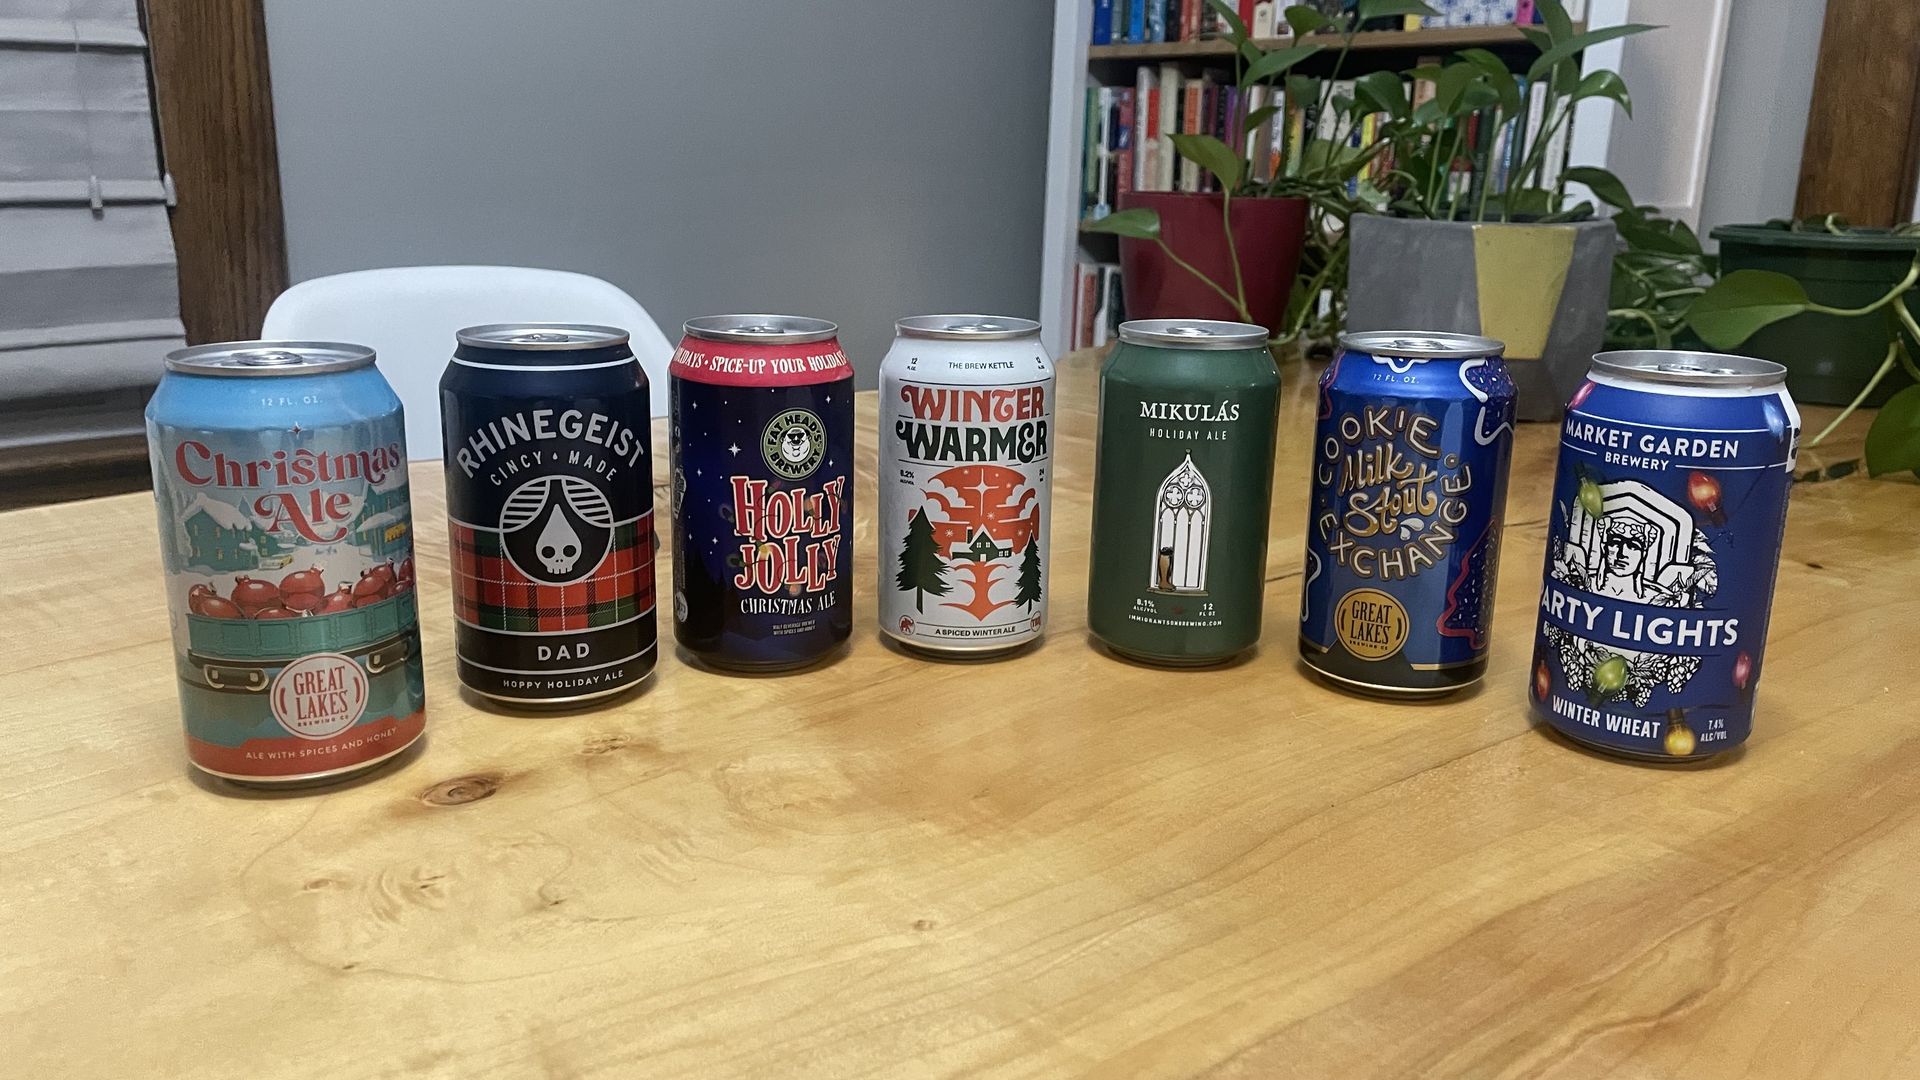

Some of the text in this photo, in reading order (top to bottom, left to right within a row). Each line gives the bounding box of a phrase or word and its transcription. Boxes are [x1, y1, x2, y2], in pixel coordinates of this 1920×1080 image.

[678, 347, 706, 369] IDAYS
[709, 355, 767, 374] SPICE-UP
[771, 357, 807, 375] YOUR
[948, 361, 1015, 370] THE BREW KETTLE
[1372, 373, 1383, 382] 12
[261, 398, 273, 407] 12
[901, 384, 1045, 423] WINTER
[1140, 400, 1241, 422] MIKULÁS
[456, 408, 645, 479] RHINEGEIST
[767, 414, 822, 446] FAT HEAD'S
[895, 419, 1048, 464] WARMER
[1150, 427, 1228, 441] HOLIDAY ALE
[1318, 405, 1440, 486] COOKIE
[1565, 418, 1739, 458] MARKET GARDEN
[175, 440, 400, 487] Christmas
[490, 449, 618, 486] CINCY MADE
[769, 448, 822, 475] BREWERY
[1338, 442, 1414, 497] Milk
[1605, 451, 1670, 471] BREWERY
[730, 475, 846, 543] HOLLY
[1343, 462, 1438, 537] Stout
[253, 488, 352, 544] Ale
[1320, 464, 1472, 580] EXCHANGE
[734, 535, 842, 595] JOLLY
[740, 591, 837, 616] CHRISTMAS ALE
[1203, 603, 1214, 611] 12
[1352, 600, 1393, 624] GREAT
[1540, 585, 1739, 647] ARTY LIGHTS
[935, 625, 1016, 637] A SPICED WINTER ALE
[1350, 618, 1391, 645] LAKES
[537, 642, 591, 661] DAD
[293, 666, 346, 696] GREAT
[503, 669, 625, 690] HOPPY HOLIDAY ALE
[295, 689, 348, 720] LAKES
[1552, 695, 1661, 739] WINTER WHEAT
[246, 726, 398, 760] ALE WITH SPICES AND HONEY
[1701, 730, 1728, 742] ALC/VOL
